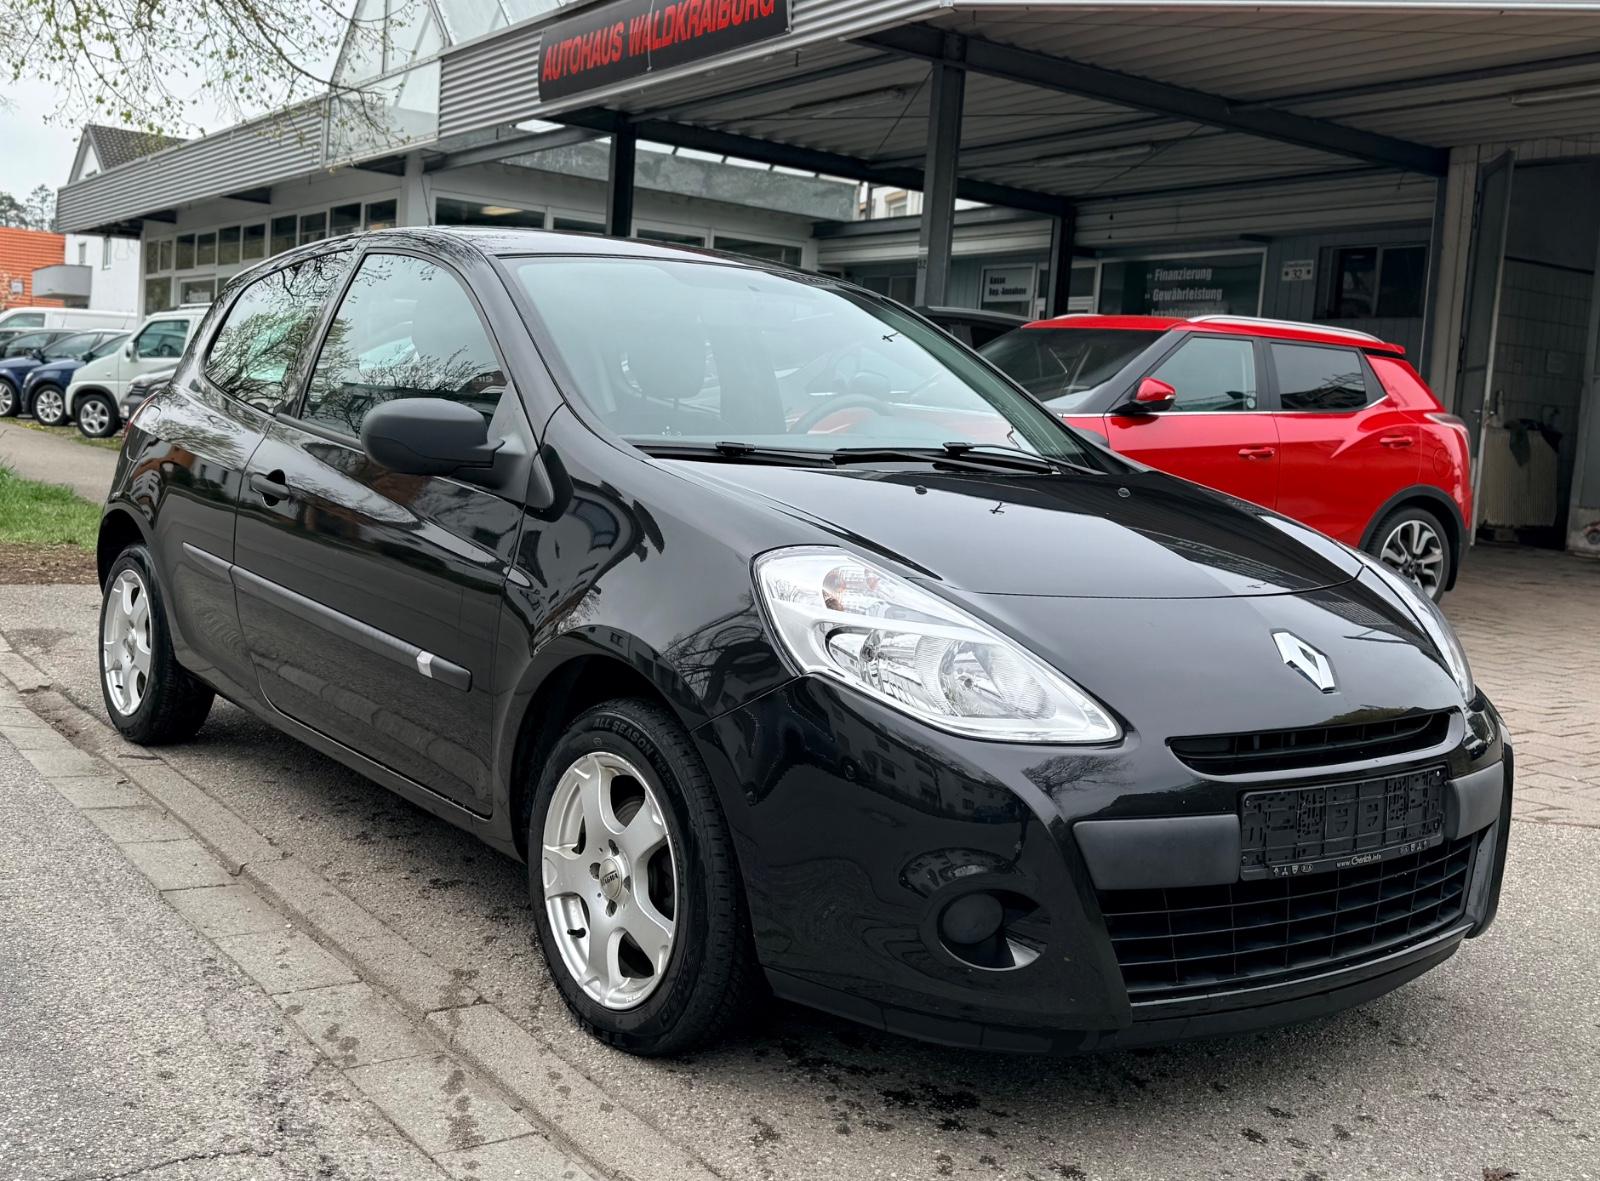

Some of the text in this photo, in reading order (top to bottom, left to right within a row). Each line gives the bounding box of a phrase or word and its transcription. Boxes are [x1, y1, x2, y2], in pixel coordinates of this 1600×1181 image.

[541, 21, 624, 82] AUTOHAUS
[1154, 267, 1213, 281] Finanzierung
[1152, 287, 1223, 302] Gewährleistung
[592, 717, 655, 756] ALL SEASON
